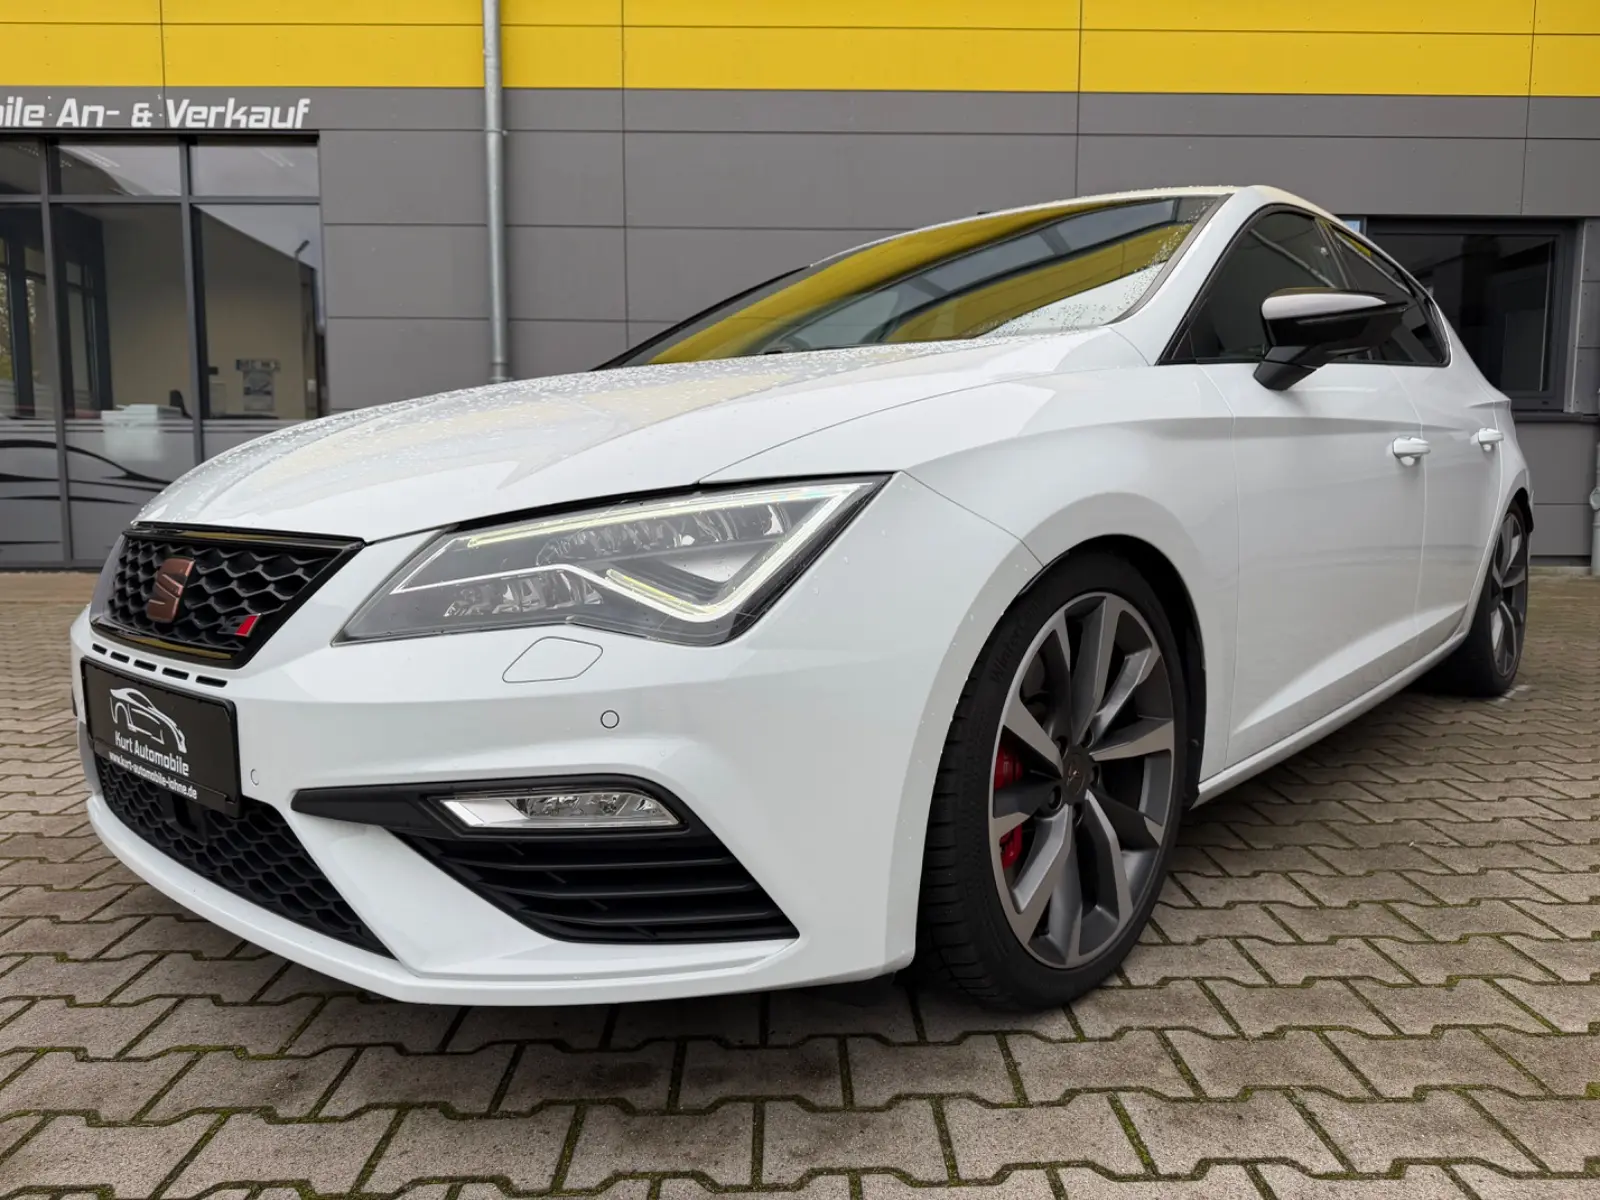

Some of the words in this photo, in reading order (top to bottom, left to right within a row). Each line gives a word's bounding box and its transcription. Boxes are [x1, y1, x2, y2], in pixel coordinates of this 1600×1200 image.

[56, 98, 120, 127] An-
[131, 103, 153, 127] &
[166, 98, 310, 128] Verkauf
[114, 730, 134, 754] Kurt
[134, 741, 190, 777] Automobile
